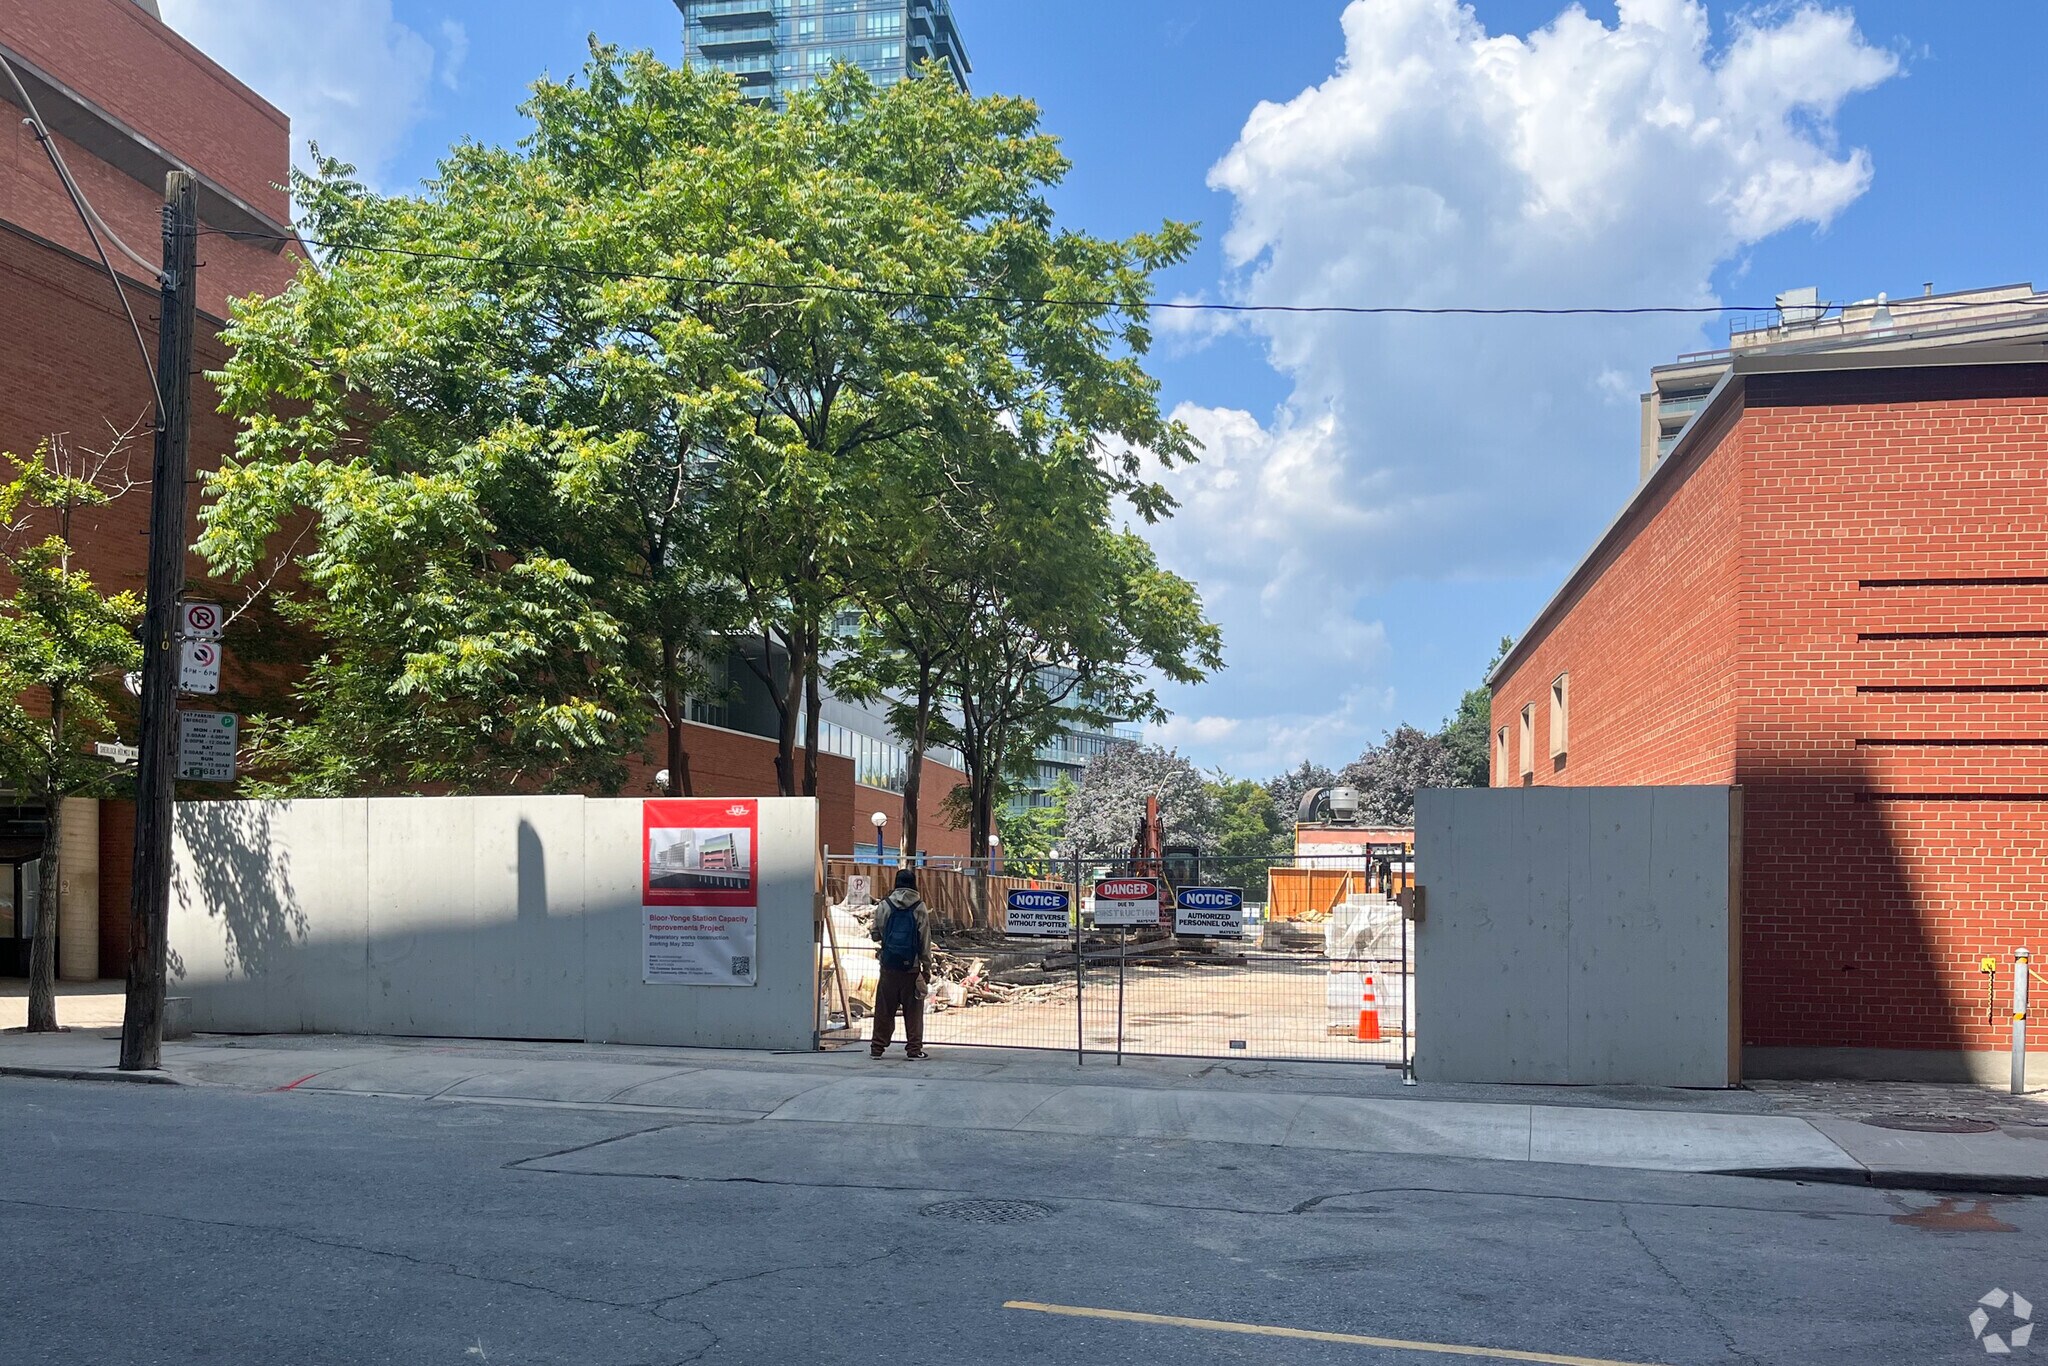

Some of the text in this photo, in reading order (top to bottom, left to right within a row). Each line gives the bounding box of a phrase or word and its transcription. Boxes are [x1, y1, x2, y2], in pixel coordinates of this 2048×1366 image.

[203, 768, 228, 776] 6811
[1104, 883, 1148, 895] DANGER
[1016, 895, 1060, 906] NOTICE
[1186, 893, 1233, 905] NOTICE
[649, 914, 749, 924] Bloor-Yonge Station Capacity
[1187, 912, 1231, 920] AUTHORIZED
[1179, 919, 1220, 927] PERSONNEL
[649, 924, 725, 933] Improvements Project
